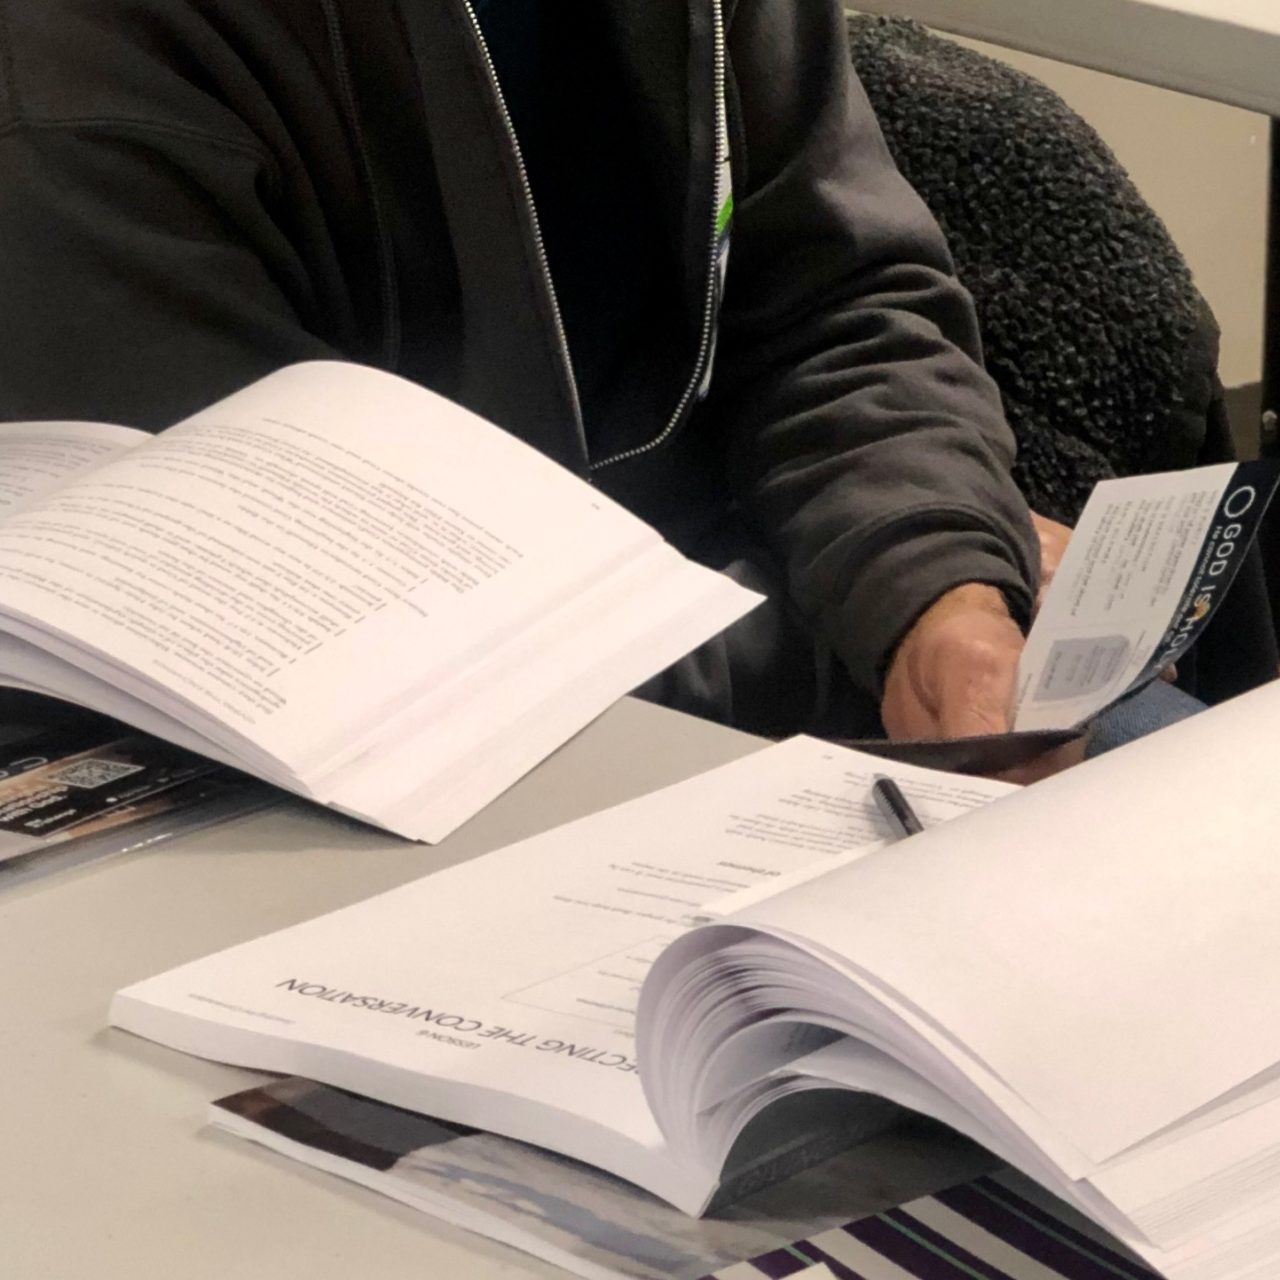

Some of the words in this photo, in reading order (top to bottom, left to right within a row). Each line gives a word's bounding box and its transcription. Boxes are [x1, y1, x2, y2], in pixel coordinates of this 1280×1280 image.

[1209, 523, 1242, 576] GOD
[1193, 584, 1217, 608] IS
[275, 978, 483, 1033] CONVERSATION
[478, 1025, 537, 1048] THE
[535, 1038, 640, 1075] ECTING
